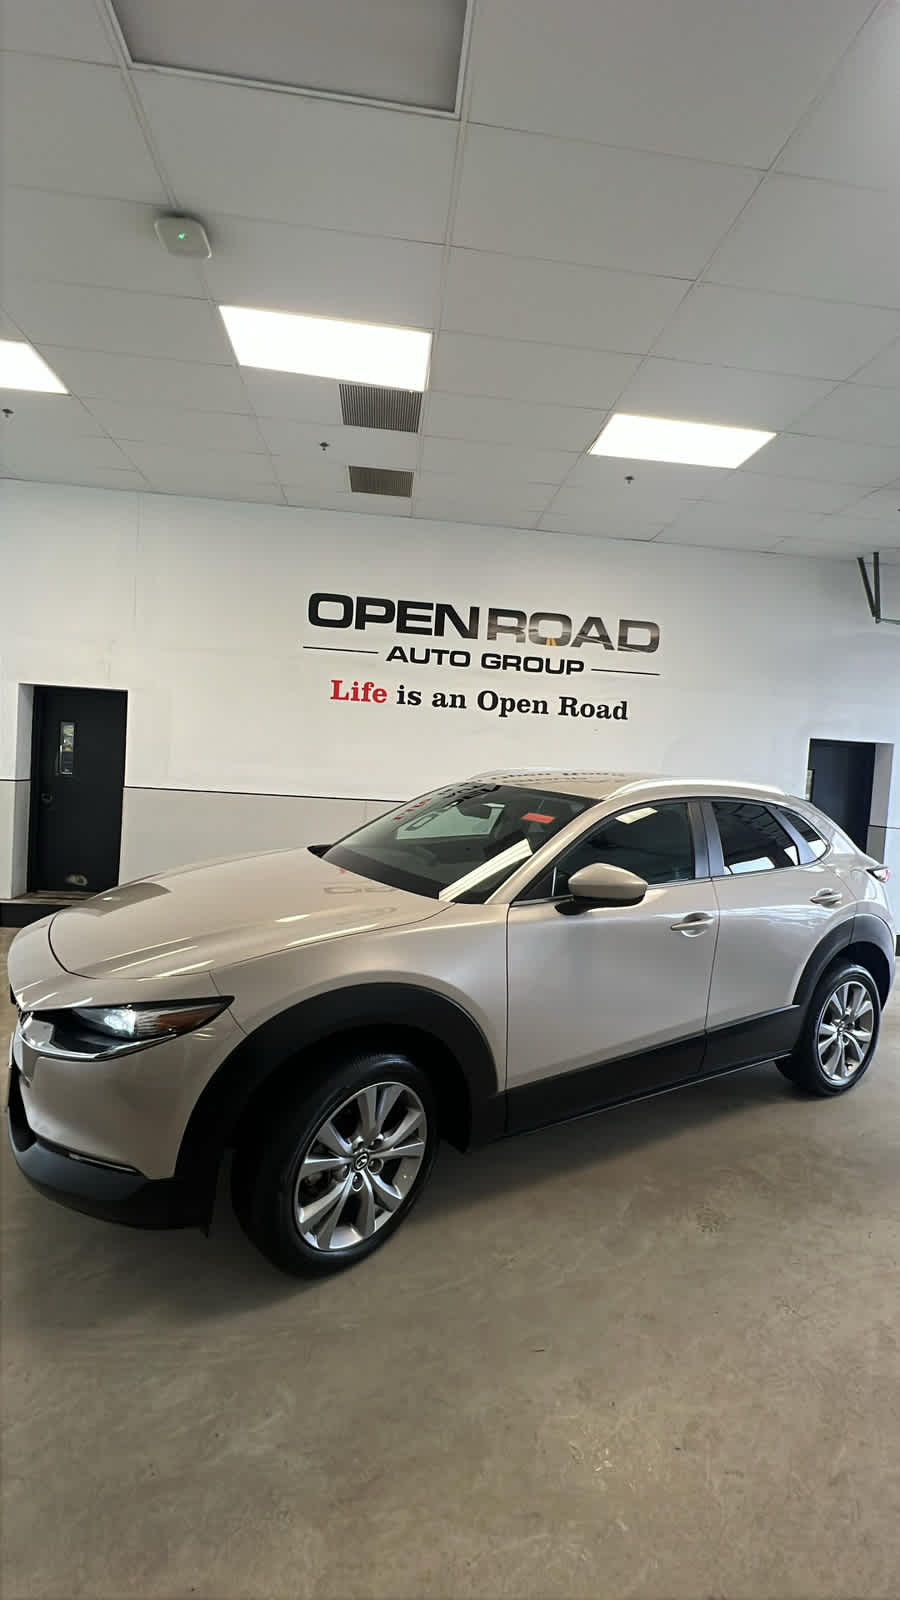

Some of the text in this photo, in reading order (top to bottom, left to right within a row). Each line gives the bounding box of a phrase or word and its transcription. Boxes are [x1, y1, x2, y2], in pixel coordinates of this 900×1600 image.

[386, 646, 584, 675] AUTO GROUP
[330, 680, 628, 720] Life is an Open Road
